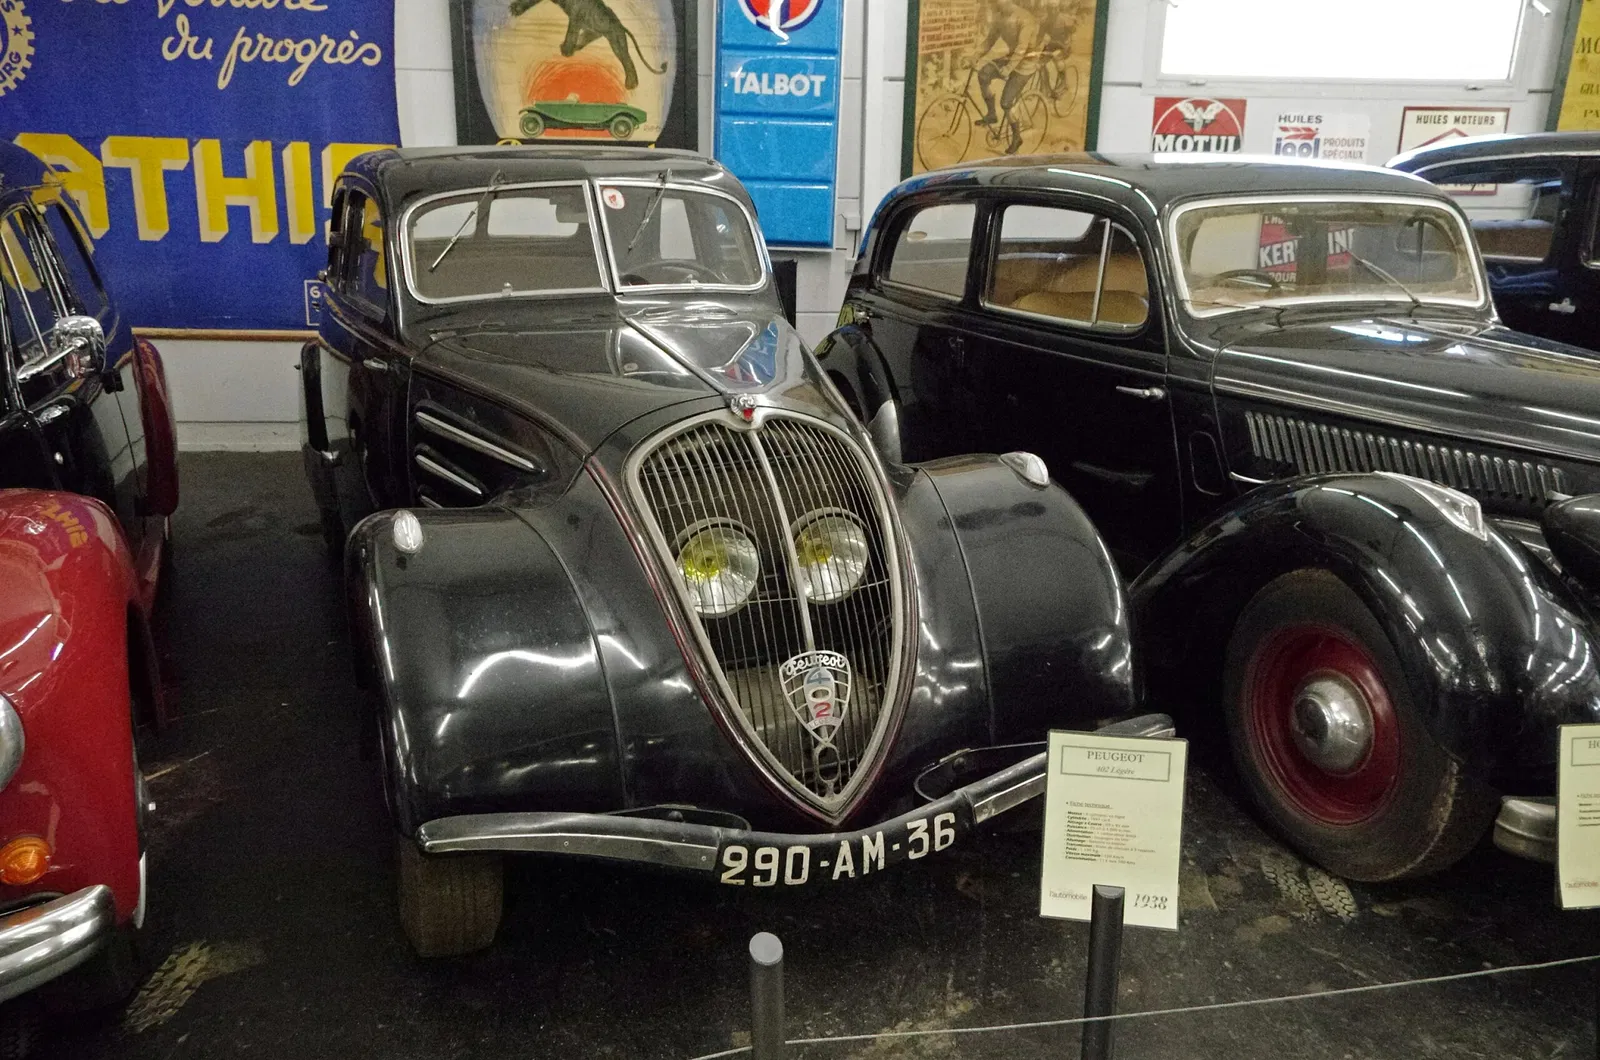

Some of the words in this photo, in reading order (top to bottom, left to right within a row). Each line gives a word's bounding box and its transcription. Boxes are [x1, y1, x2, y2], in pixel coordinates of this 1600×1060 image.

[162, 14, 213, 61] du
[217, 27, 382, 90] progrès
[730, 71, 826, 97] TALBOT
[1278, 115, 1323, 124] HUILES
[1416, 115, 1448, 124] HUILES
[1453, 116, 1496, 125] MOTEURS
[1153, 134, 1241, 153] MOTUL
[1323, 138, 1365, 148] PRODUITS
[785, 655, 846, 676] Peugeot
[1087, 751, 1145, 763] PEUGEOT
[720, 812, 956, 887] 290-AM-36
[1133, 893, 1168, 911] 1938
